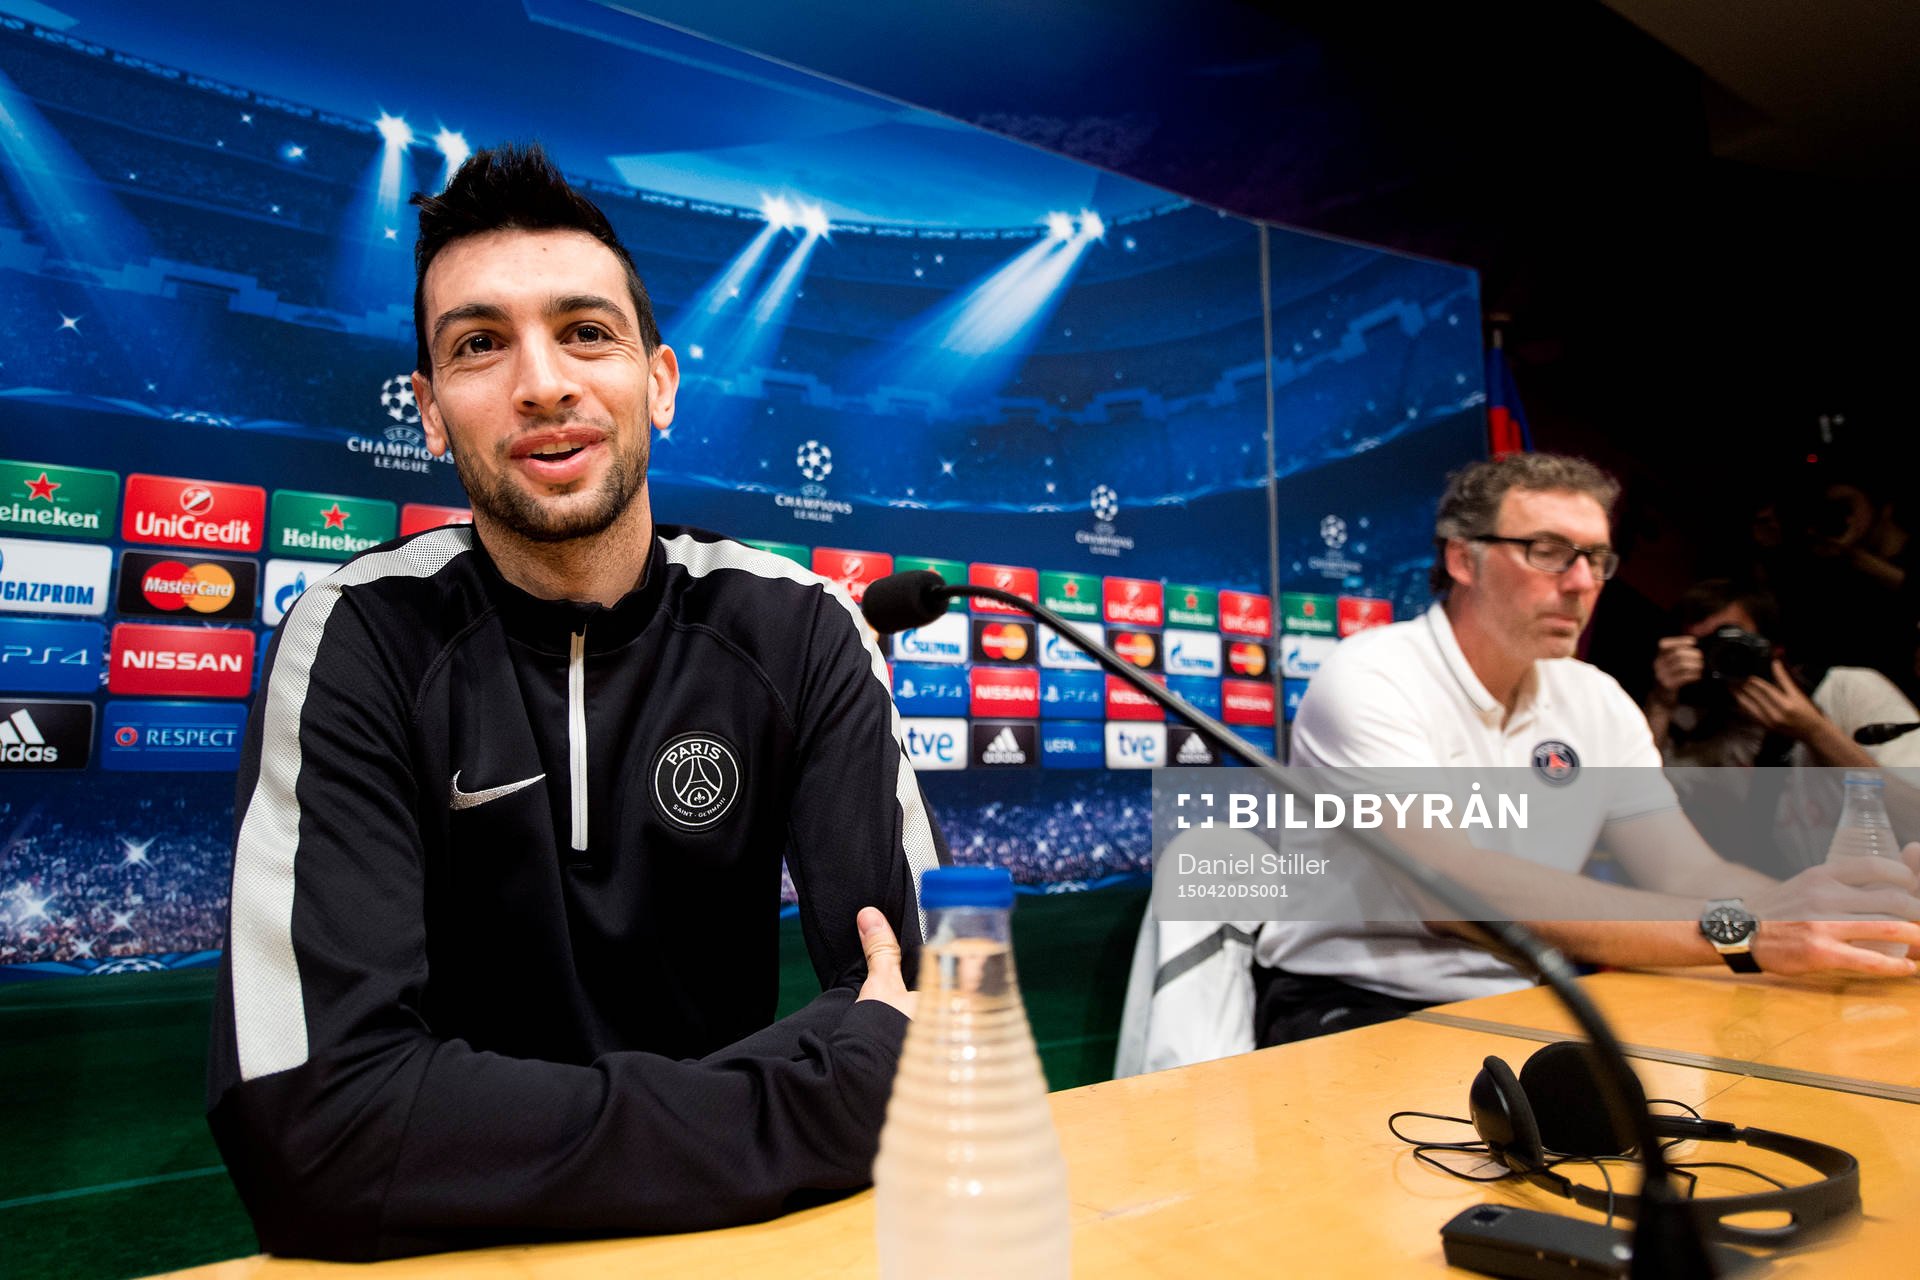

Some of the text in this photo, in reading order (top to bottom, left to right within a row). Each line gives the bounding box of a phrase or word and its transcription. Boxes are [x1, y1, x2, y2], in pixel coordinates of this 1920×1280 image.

[374, 454, 431, 474] LEAGUE
[0, 503, 99, 529] eineken
[135, 511, 251, 545] UniCredit
[4, 581, 94, 606] GAZPROM
[143, 577, 233, 597] MasterCard
[2, 645, 90, 666] PS4
[122, 650, 242, 673] NISSAN
[146, 729, 237, 746] RESPECT
[908, 727, 953, 762] tve
[1118, 731, 1155, 762] tve
[0, 742, 58, 762] idas
[666, 743, 721, 766] PARIS
[673, 804, 693, 817] SAINT
